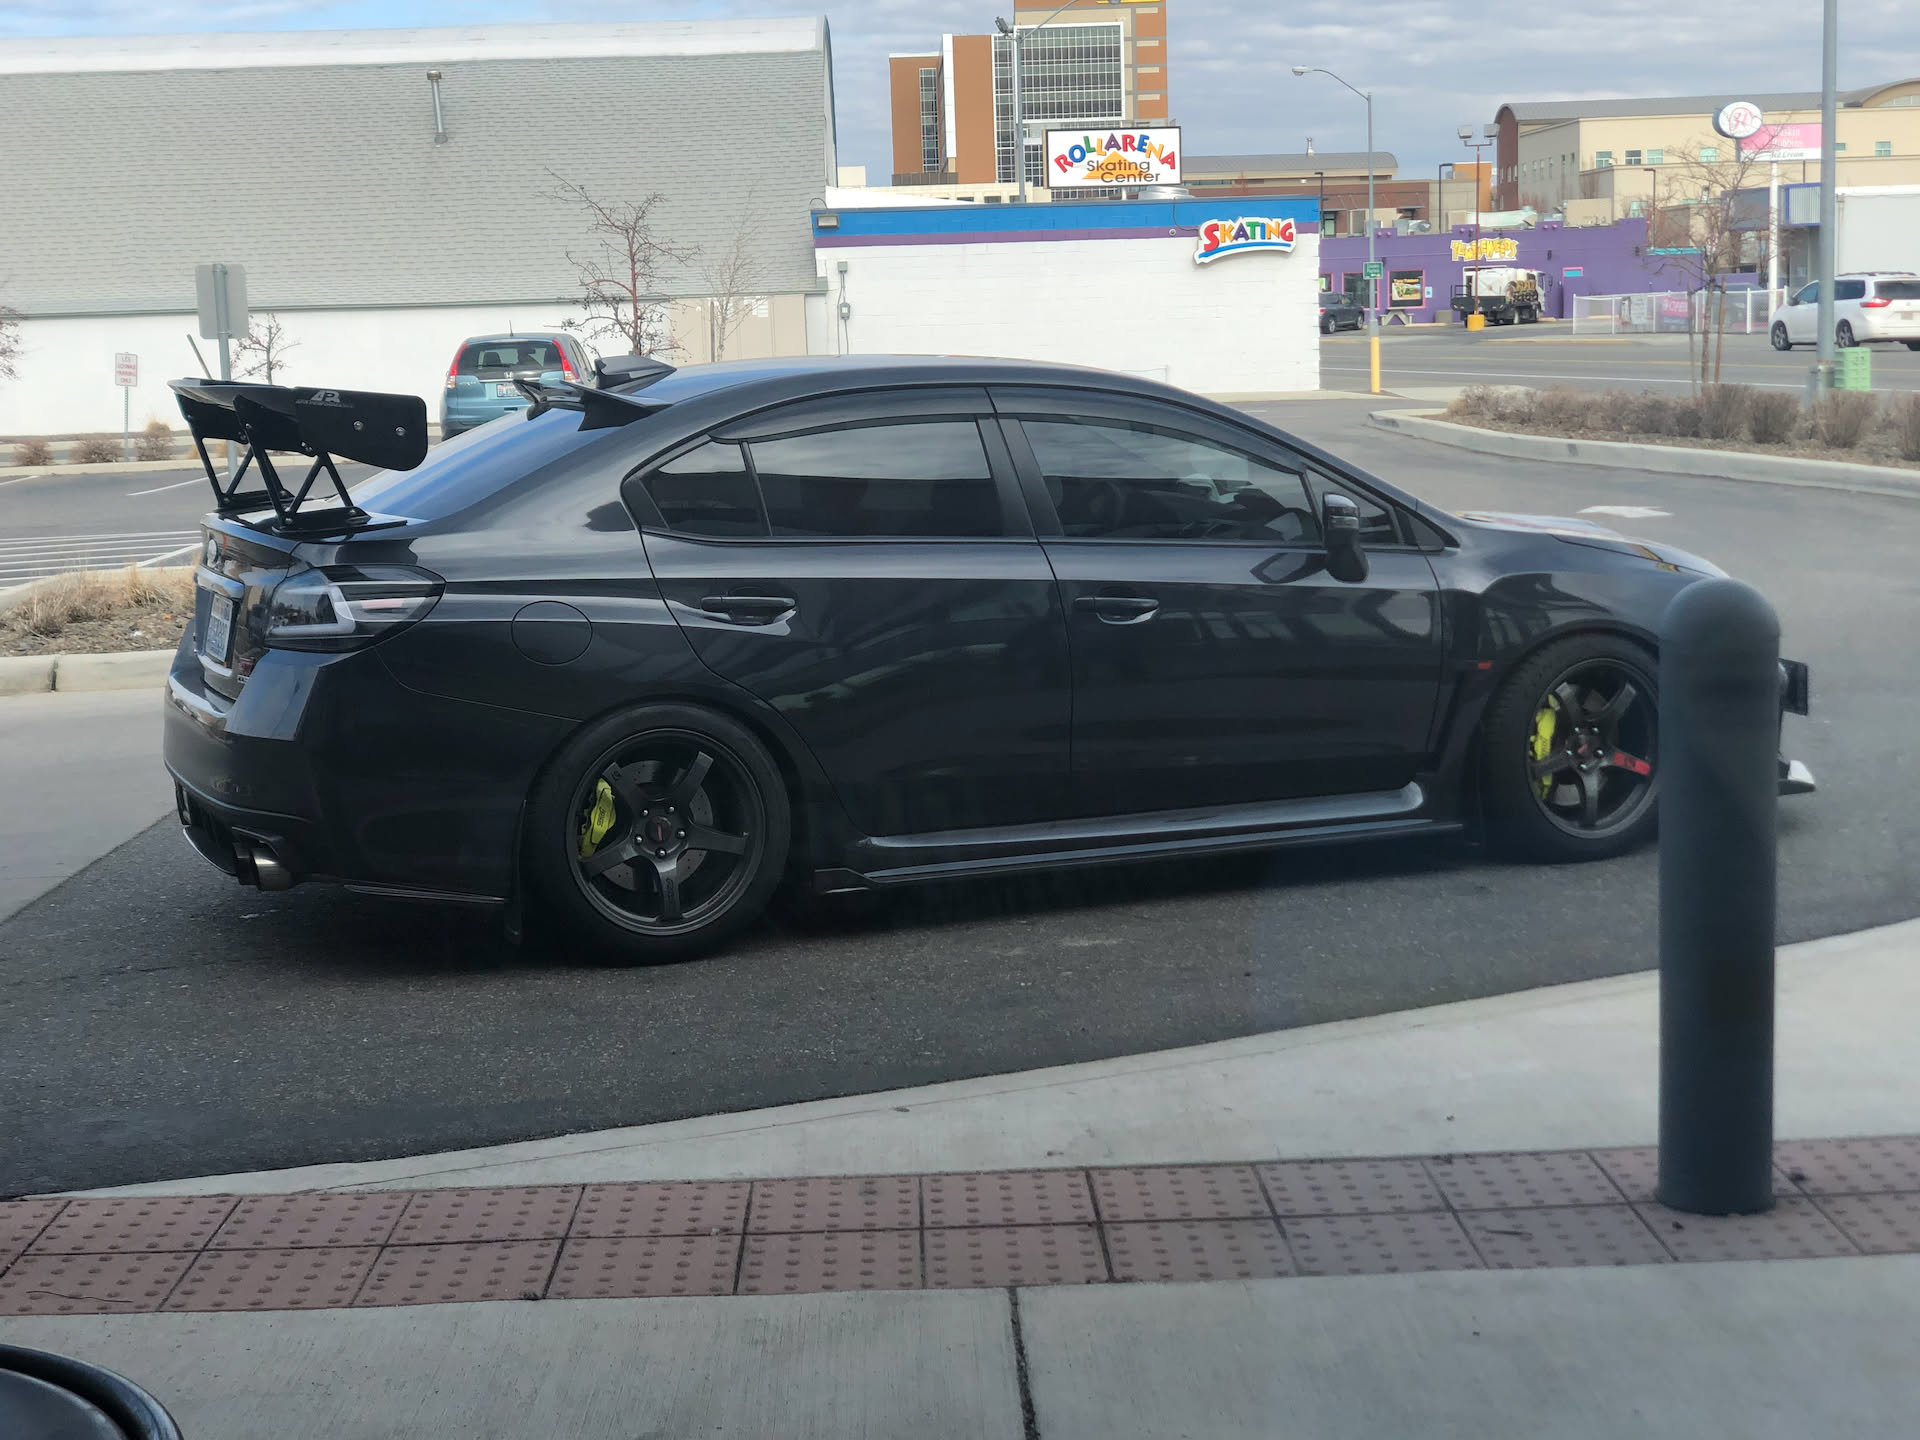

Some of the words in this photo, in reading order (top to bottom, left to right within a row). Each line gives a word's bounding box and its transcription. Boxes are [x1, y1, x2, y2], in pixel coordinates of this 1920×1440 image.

[1054, 133, 1176, 173] ROLLARENA
[1087, 159, 1150, 174] Skating
[1100, 170, 1161, 183] Center
[1203, 221, 1294, 252] SKATING
